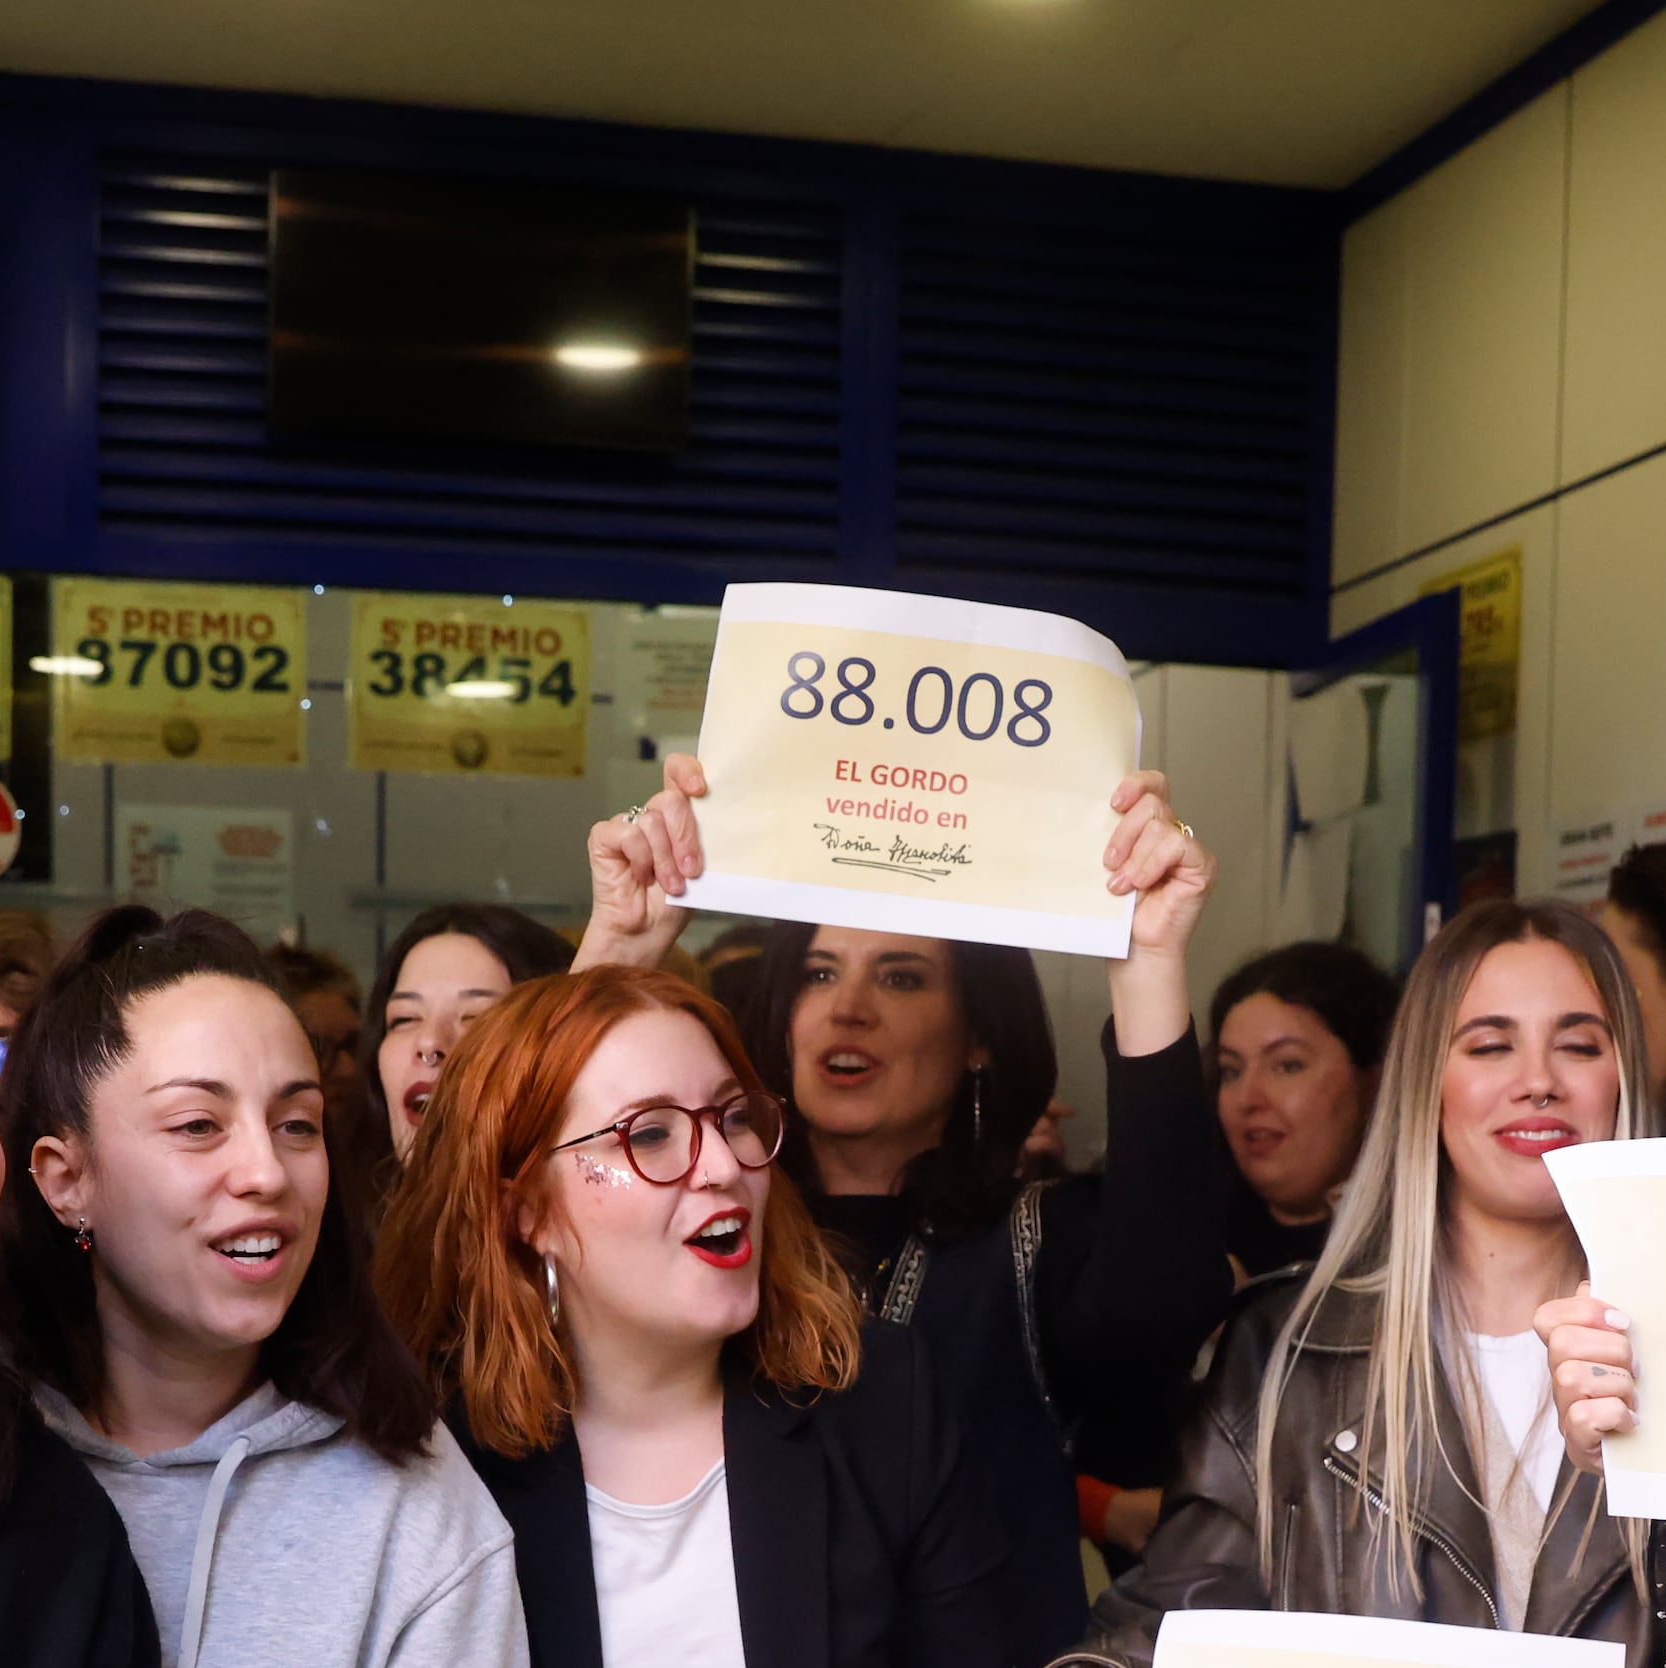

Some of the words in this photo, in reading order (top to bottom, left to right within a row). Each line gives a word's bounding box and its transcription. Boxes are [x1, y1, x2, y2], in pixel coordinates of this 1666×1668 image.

[121, 607, 276, 643] PREMIO
[414, 620, 564, 658] PREMIO
[780, 649, 1054, 748] 88.008
[834, 759, 863, 784] EL
[869, 763, 970, 796] GORDO
[825, 792, 932, 830] vendido
[936, 807, 969, 831] en
